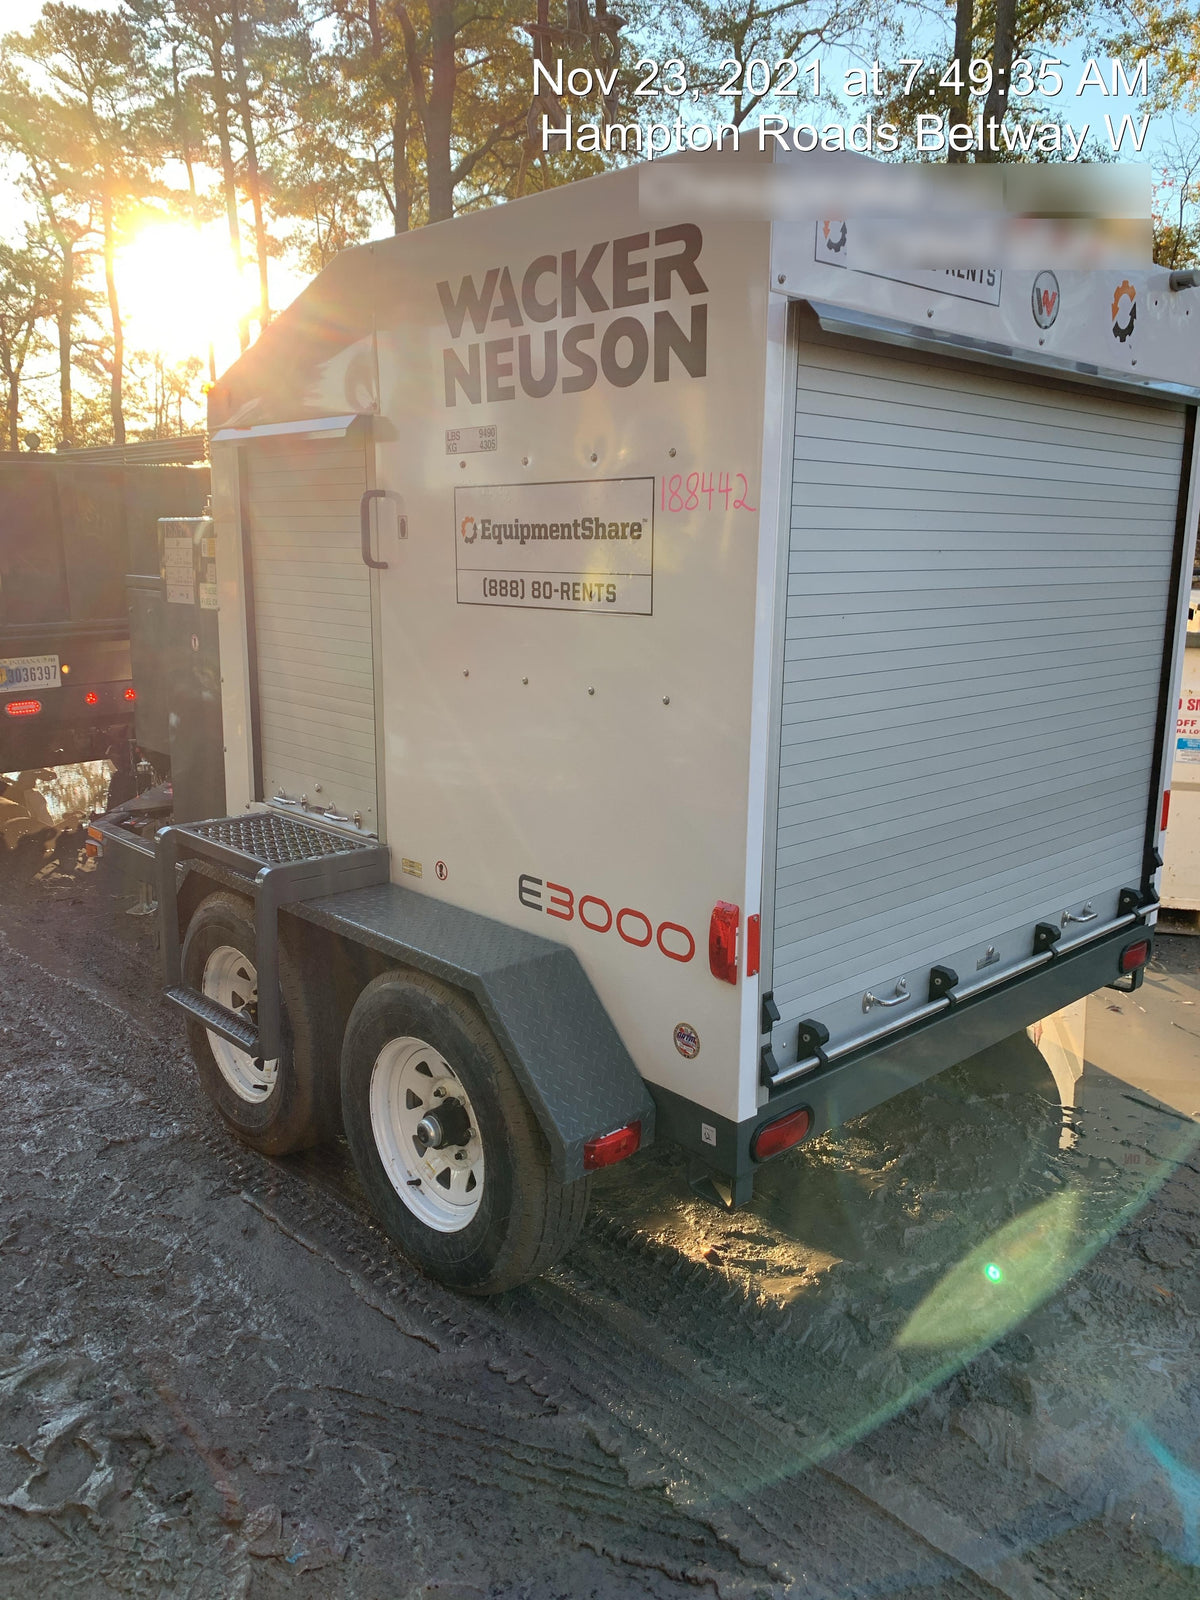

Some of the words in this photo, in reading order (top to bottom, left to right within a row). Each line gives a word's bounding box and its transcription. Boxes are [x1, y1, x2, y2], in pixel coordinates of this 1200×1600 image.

[436, 223, 709, 339] WACKER
[443, 303, 708, 407] NEUSON
[447, 431, 461, 441] LBS
[447, 442, 458, 453] KG
[480, 439, 496, 450] 4305
[661, 471, 757, 513] 188442
[480, 517, 643, 545] EquipmentShare
[482, 577, 525, 600] (888)
[531, 580, 617, 603] 80-RENTS
[518, 873, 696, 963] E3000
